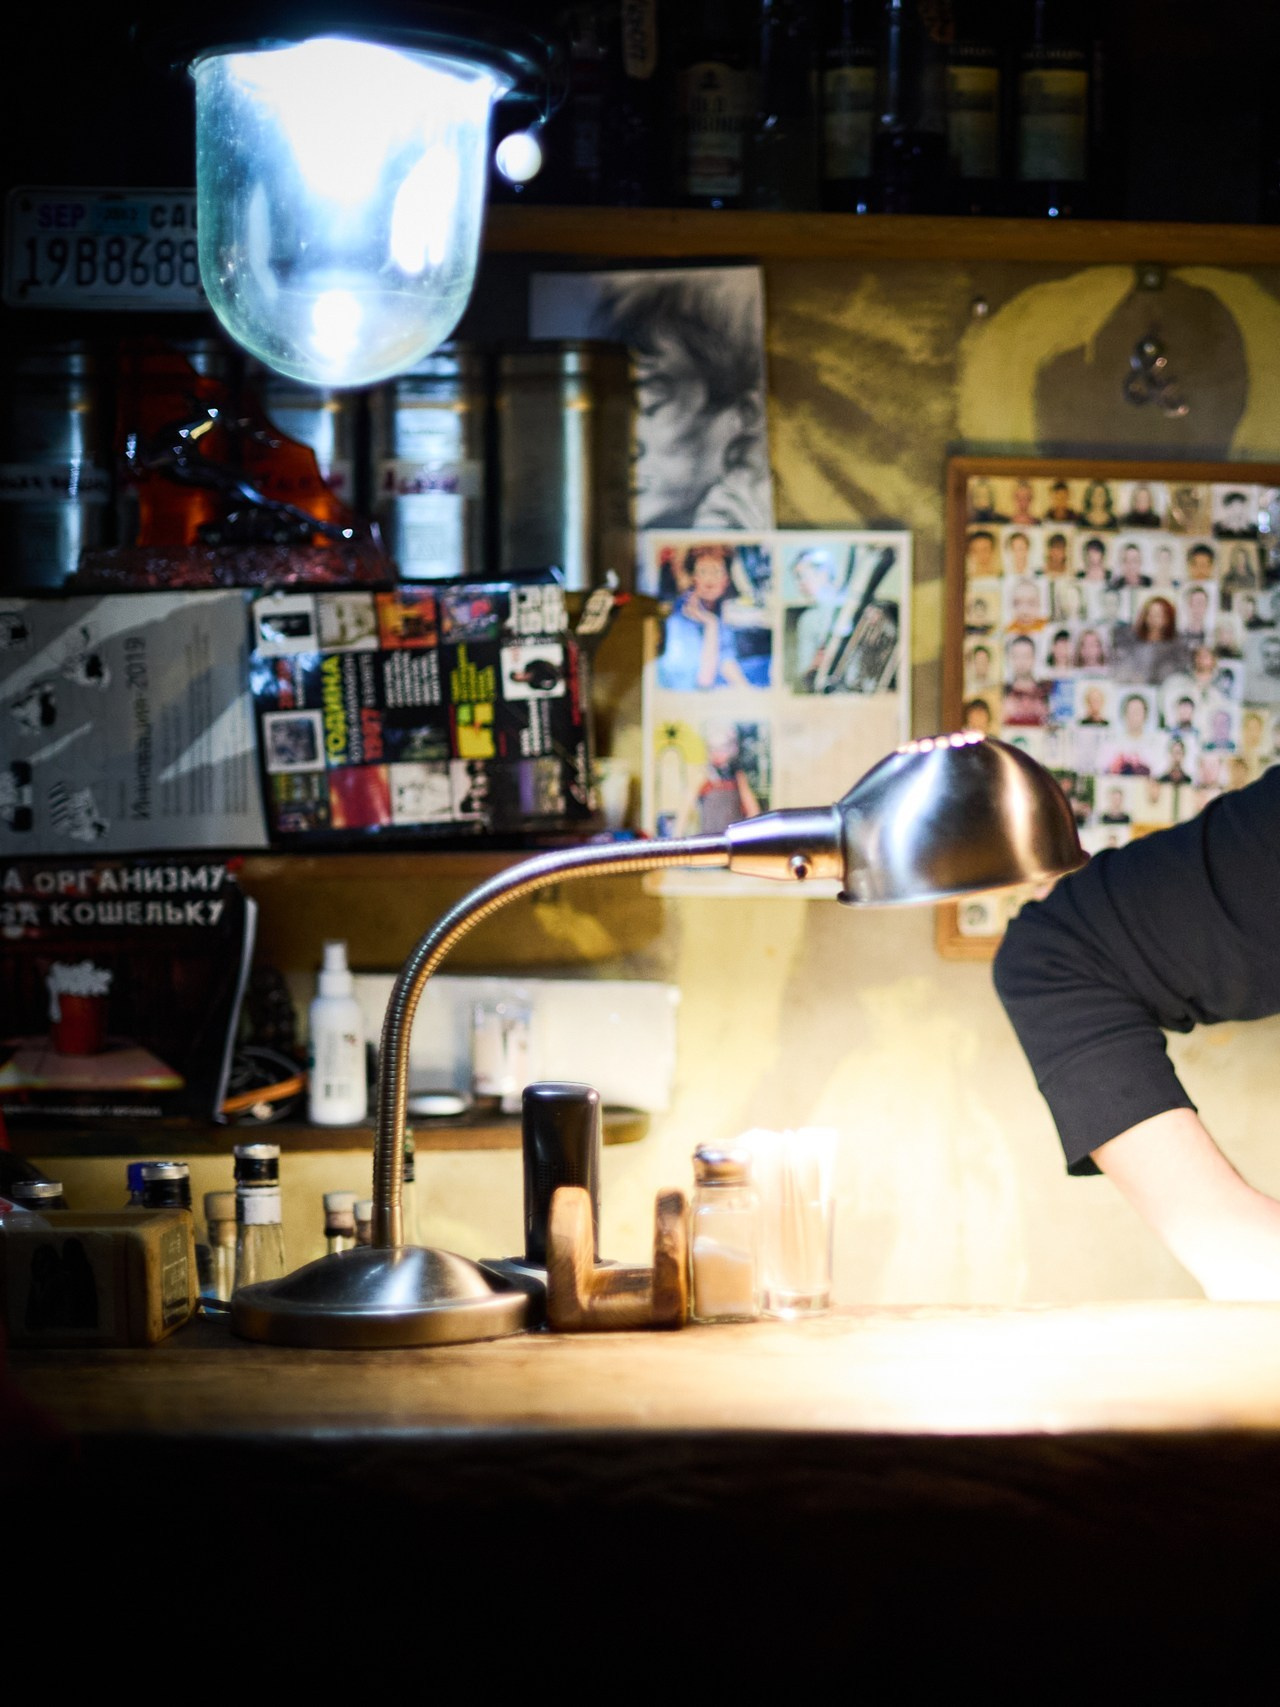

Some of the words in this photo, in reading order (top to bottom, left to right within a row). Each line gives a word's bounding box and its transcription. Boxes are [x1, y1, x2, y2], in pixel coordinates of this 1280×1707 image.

[37, 203, 85, 228] SEP
[34, 864, 226, 893] ОРГАНИЗМУ
[51, 899, 226, 926] КОШЕЛЬКУ
